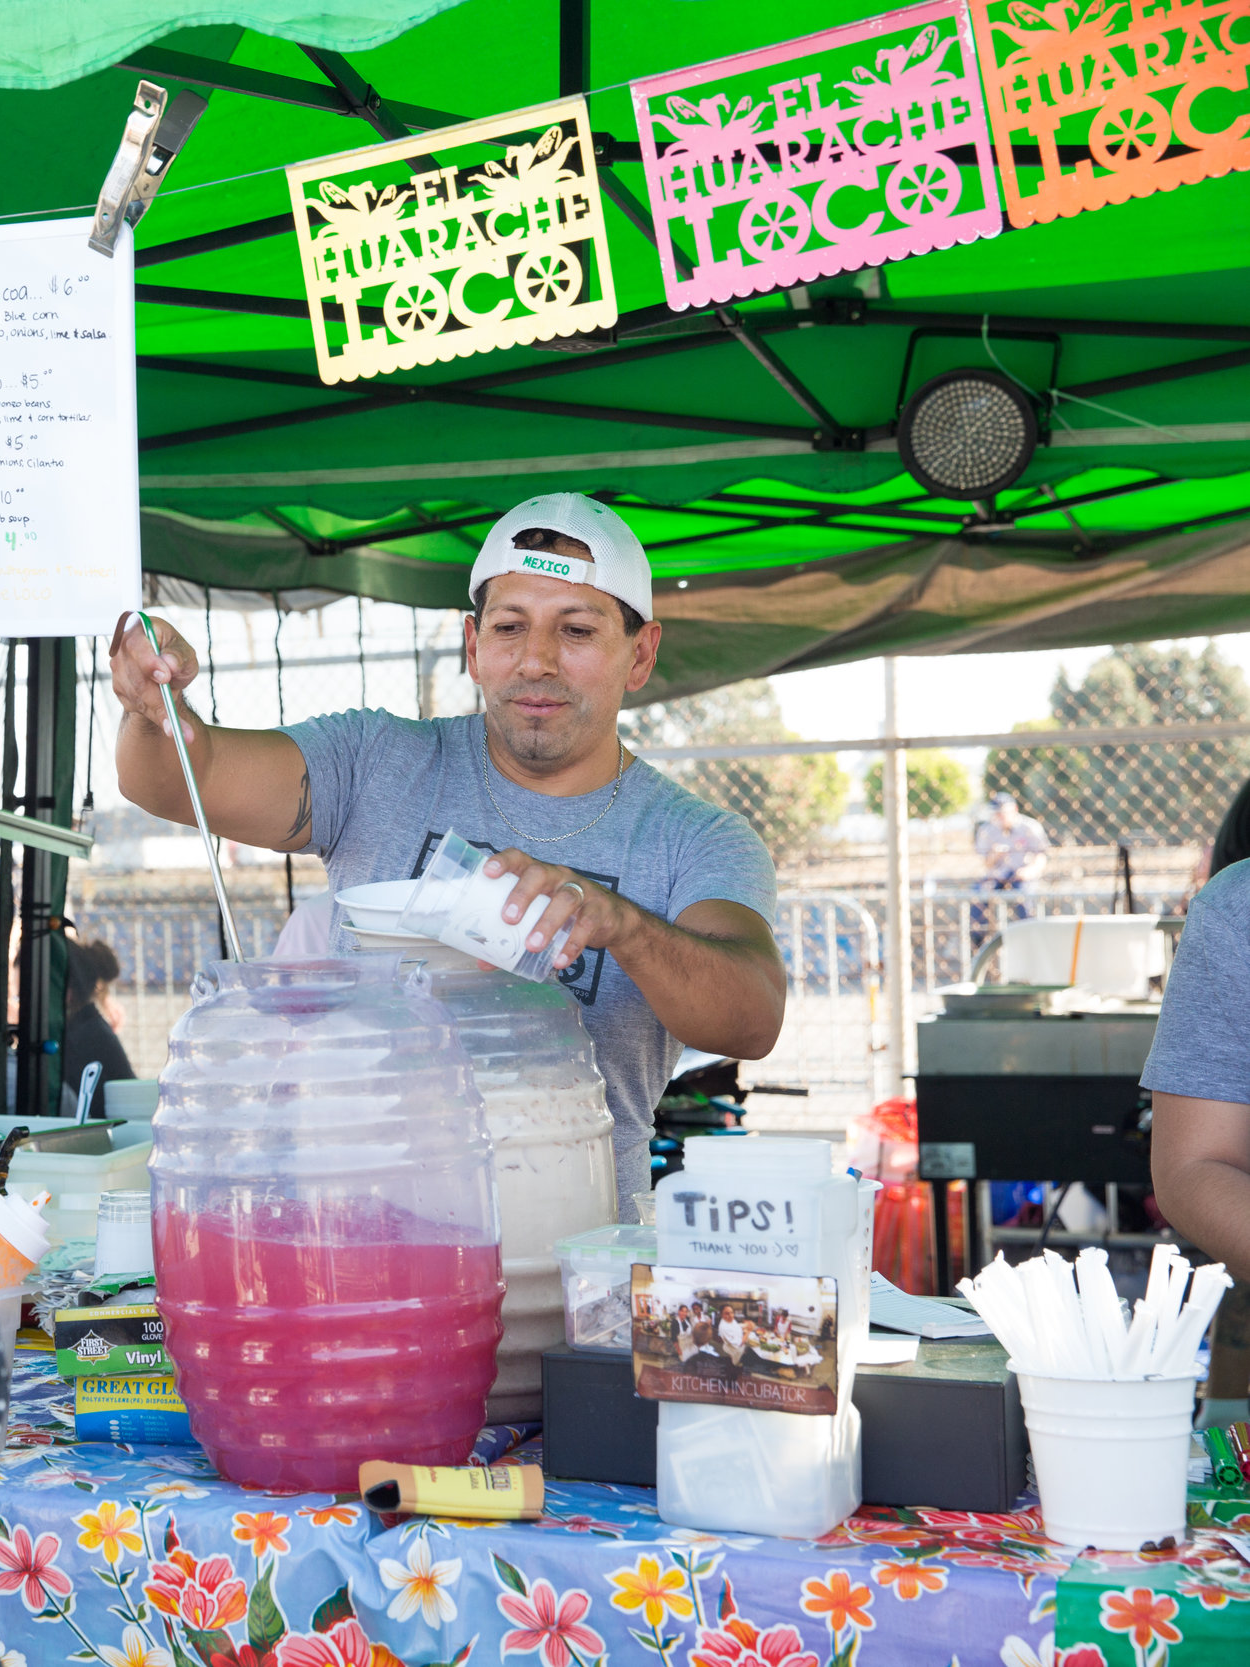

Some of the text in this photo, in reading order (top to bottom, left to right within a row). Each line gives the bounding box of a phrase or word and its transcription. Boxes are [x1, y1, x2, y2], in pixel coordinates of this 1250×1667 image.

[1000, 12, 1250, 113] HUARAC
[768, 73, 839, 127] EL
[1027, 64, 1250, 194] LOC
[660, 98, 972, 202] HUARACHE
[410, 166, 474, 216] EL
[685, 151, 962, 281] LOCO
[316, 193, 591, 282] HUARACHE
[335, 244, 583, 352] LOCO
[4, 311, 27, 322] Blue
[32, 311, 59, 321] corn
[50, 329, 70, 339] lime
[37, 414, 55, 422] corn
[8, 515, 31, 527] soup
[522, 556, 570, 575] MEXICO
[688, 1240, 733, 1255] THANK
[738, 1242, 768, 1256] YOU
[140, 1307, 158, 1315] GRA
[142, 1321, 164, 1334] 100
[80, 1338, 105, 1348] FIRST
[141, 1333, 164, 1341] GLOVE
[76, 1345, 109, 1356] STREET
[125, 1349, 163, 1367] Vinyl
[82, 1379, 145, 1395] GREAT
[671, 1376, 728, 1395] KITCHEN
[731, 1382, 807, 1403] INCUBATOR
